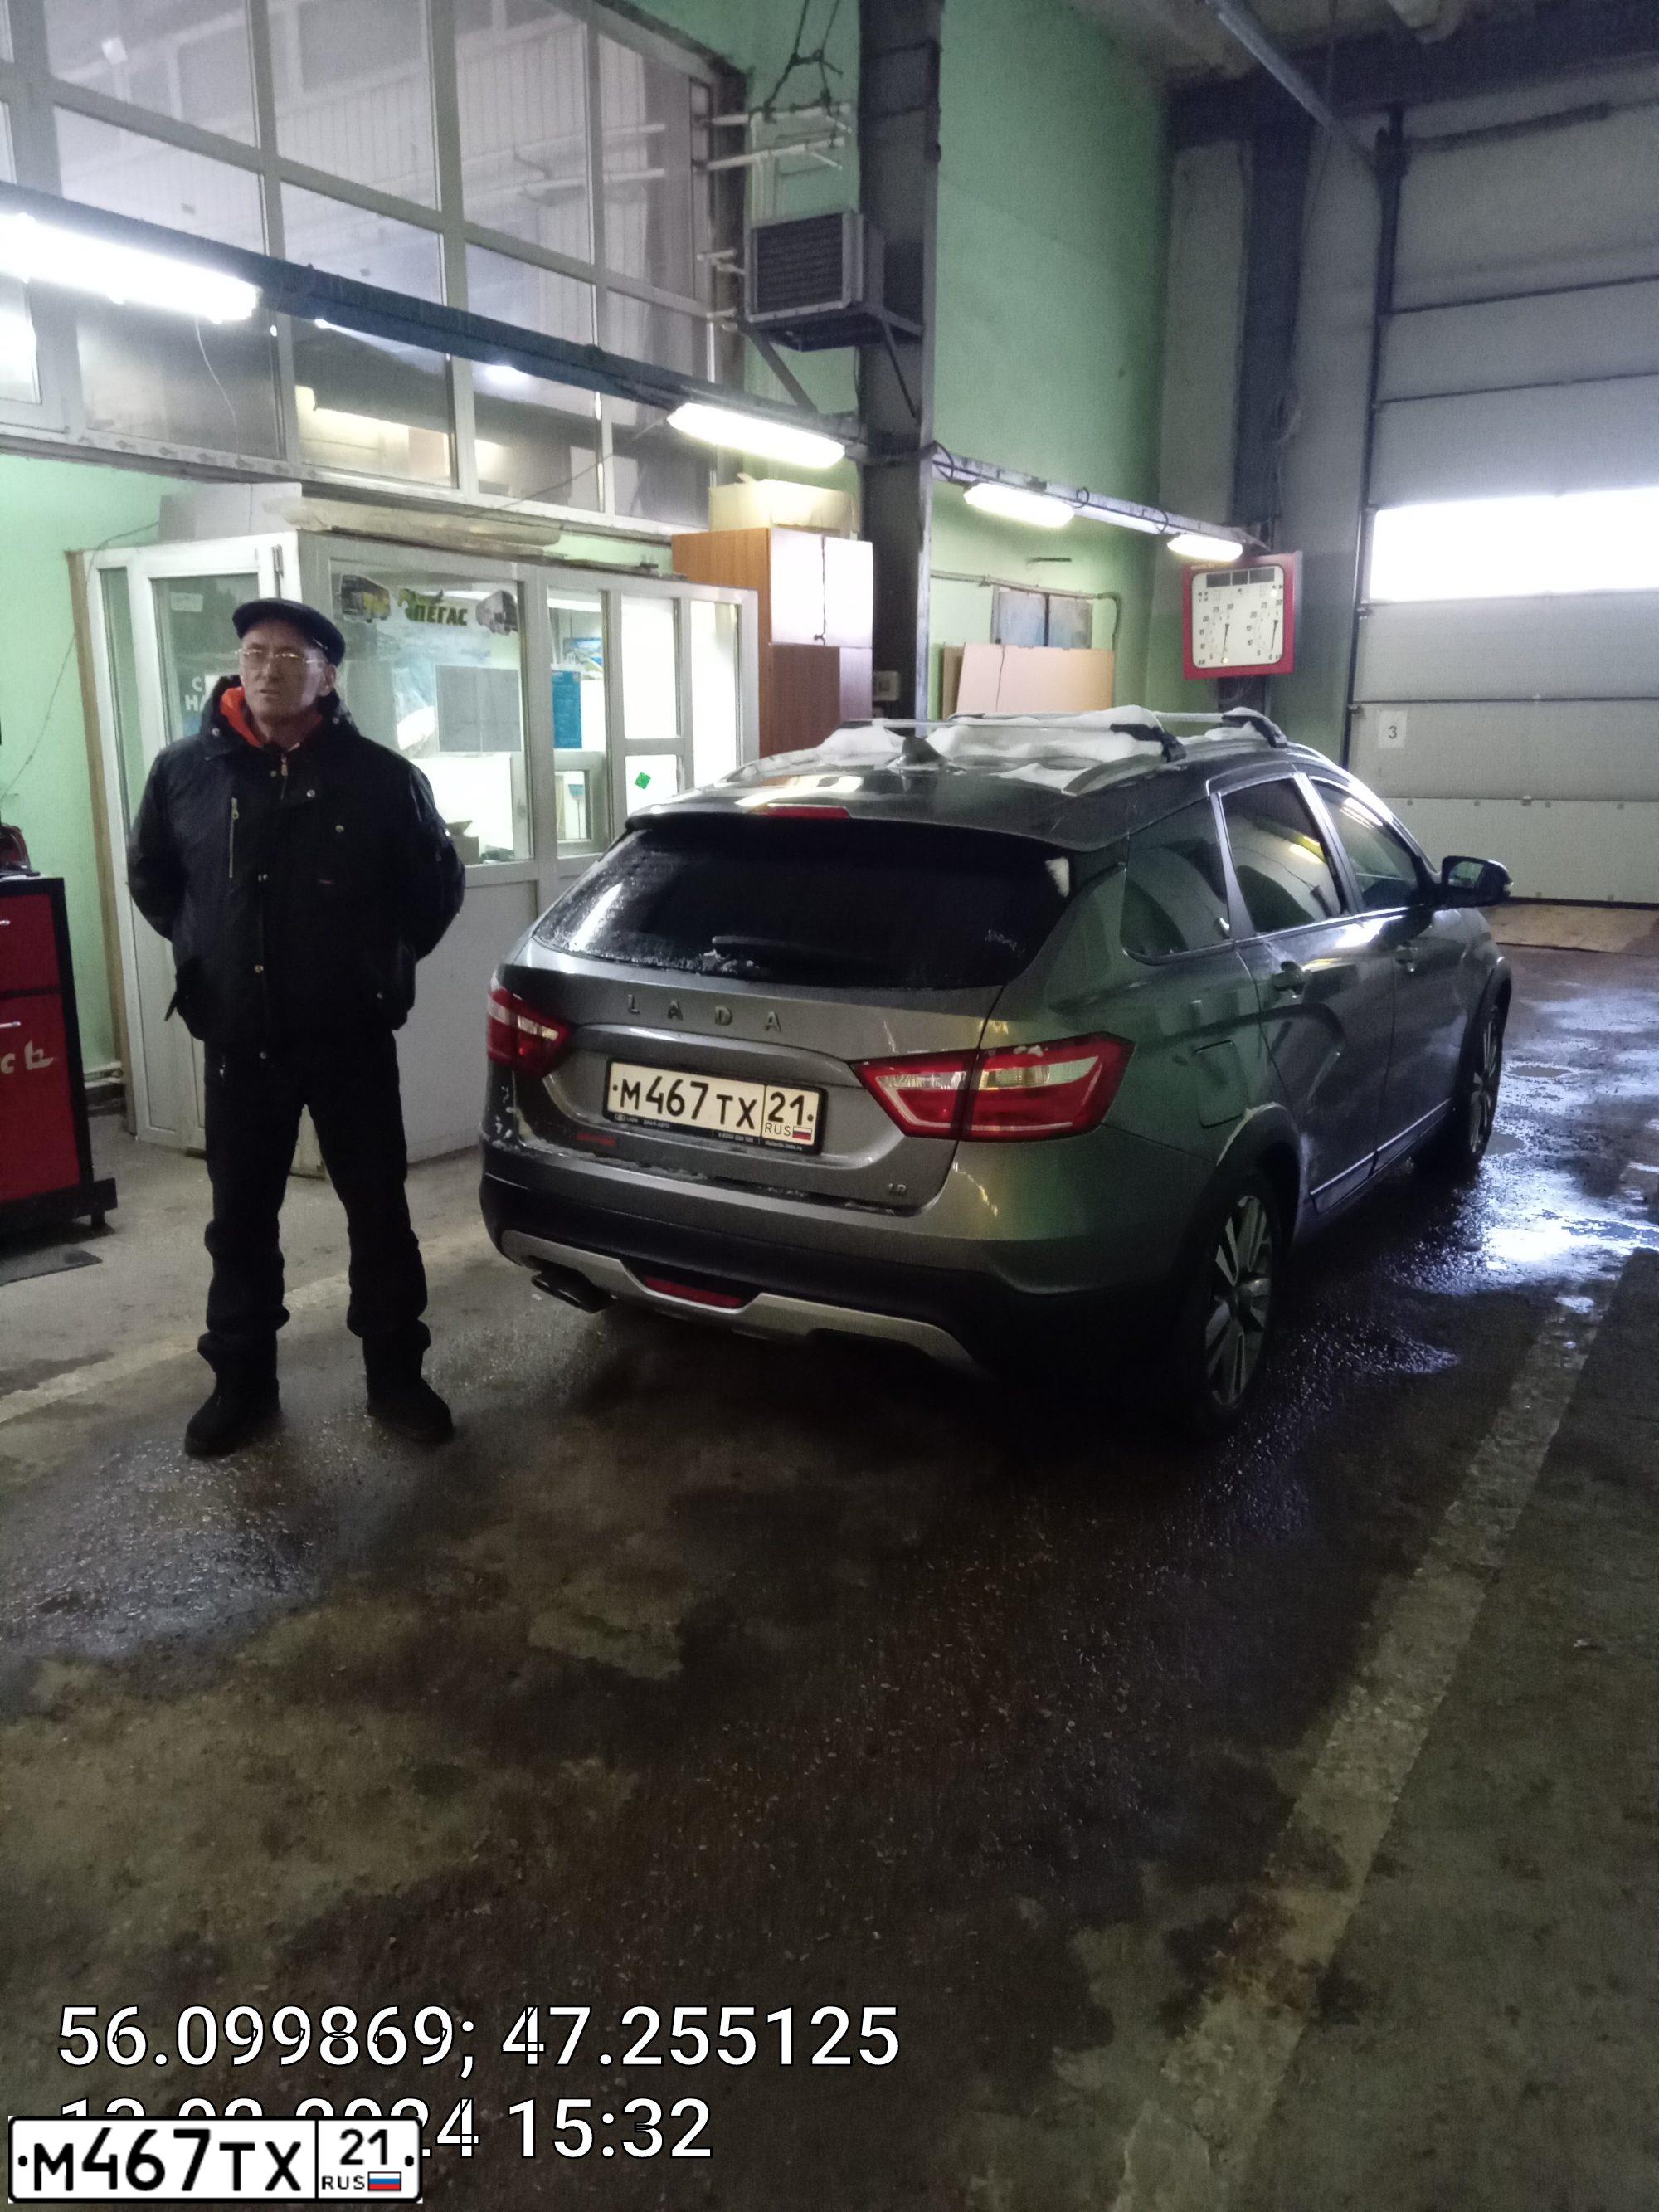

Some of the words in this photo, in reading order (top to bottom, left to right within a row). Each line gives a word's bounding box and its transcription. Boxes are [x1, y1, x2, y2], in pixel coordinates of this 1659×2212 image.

[414, 604, 468, 626] ПЕГАС
[1389, 725, 1398, 739] 3
[627, 994, 782, 1033] LADA
[767, 1091, 804, 1126] 21
[765, 1122, 791, 1138] RUS
